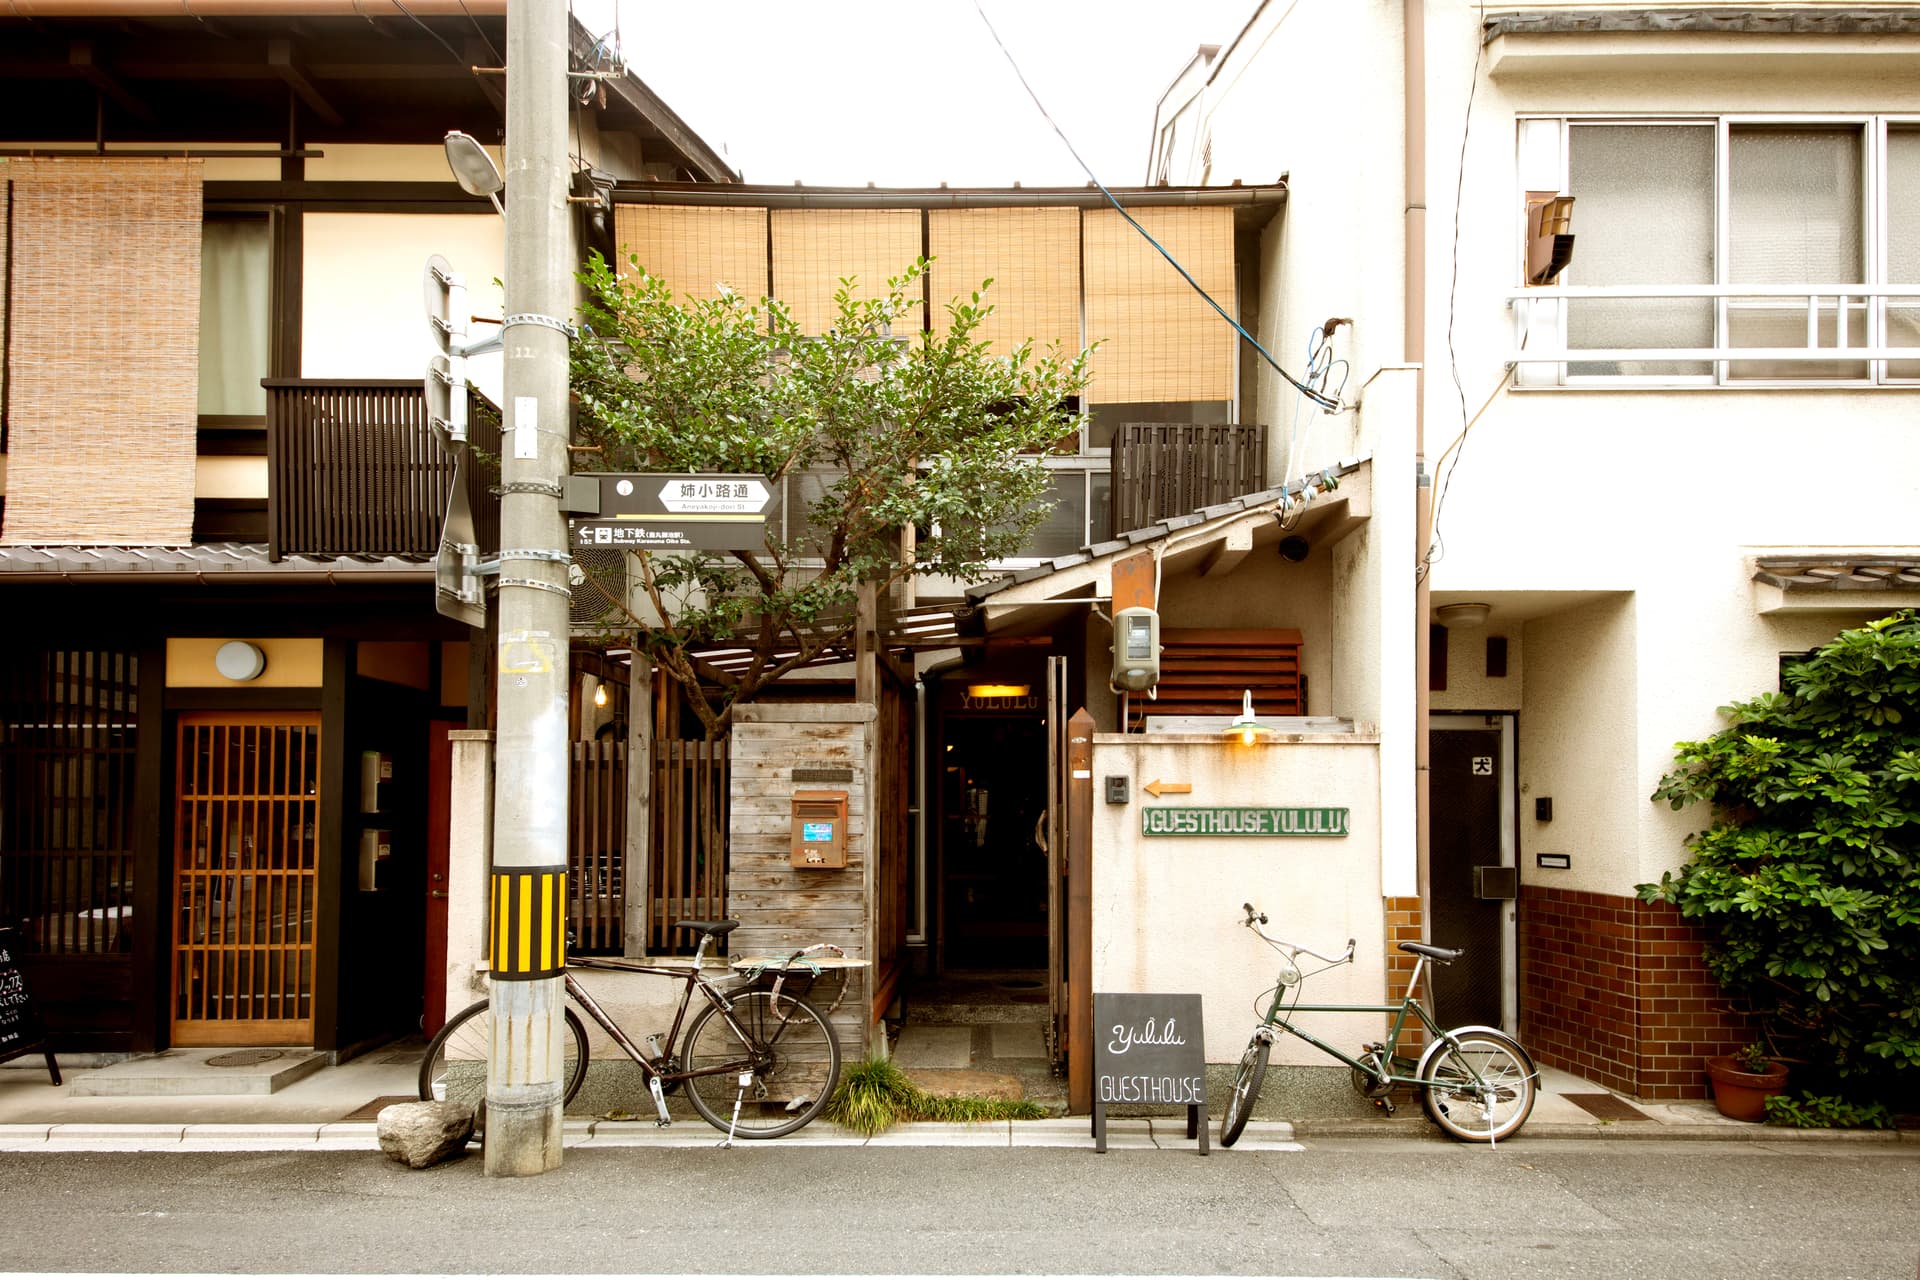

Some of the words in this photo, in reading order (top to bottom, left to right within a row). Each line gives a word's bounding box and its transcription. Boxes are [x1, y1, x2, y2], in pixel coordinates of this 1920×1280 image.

[680, 483, 749, 499] 姉小路通
[1474, 758, 1490, 773] 犬
[1150, 809, 1269, 833] GUESTHOUSE
[1269, 809, 1342, 833] YULULU
[1100, 1075, 1203, 1103] GUESTHOUSE
